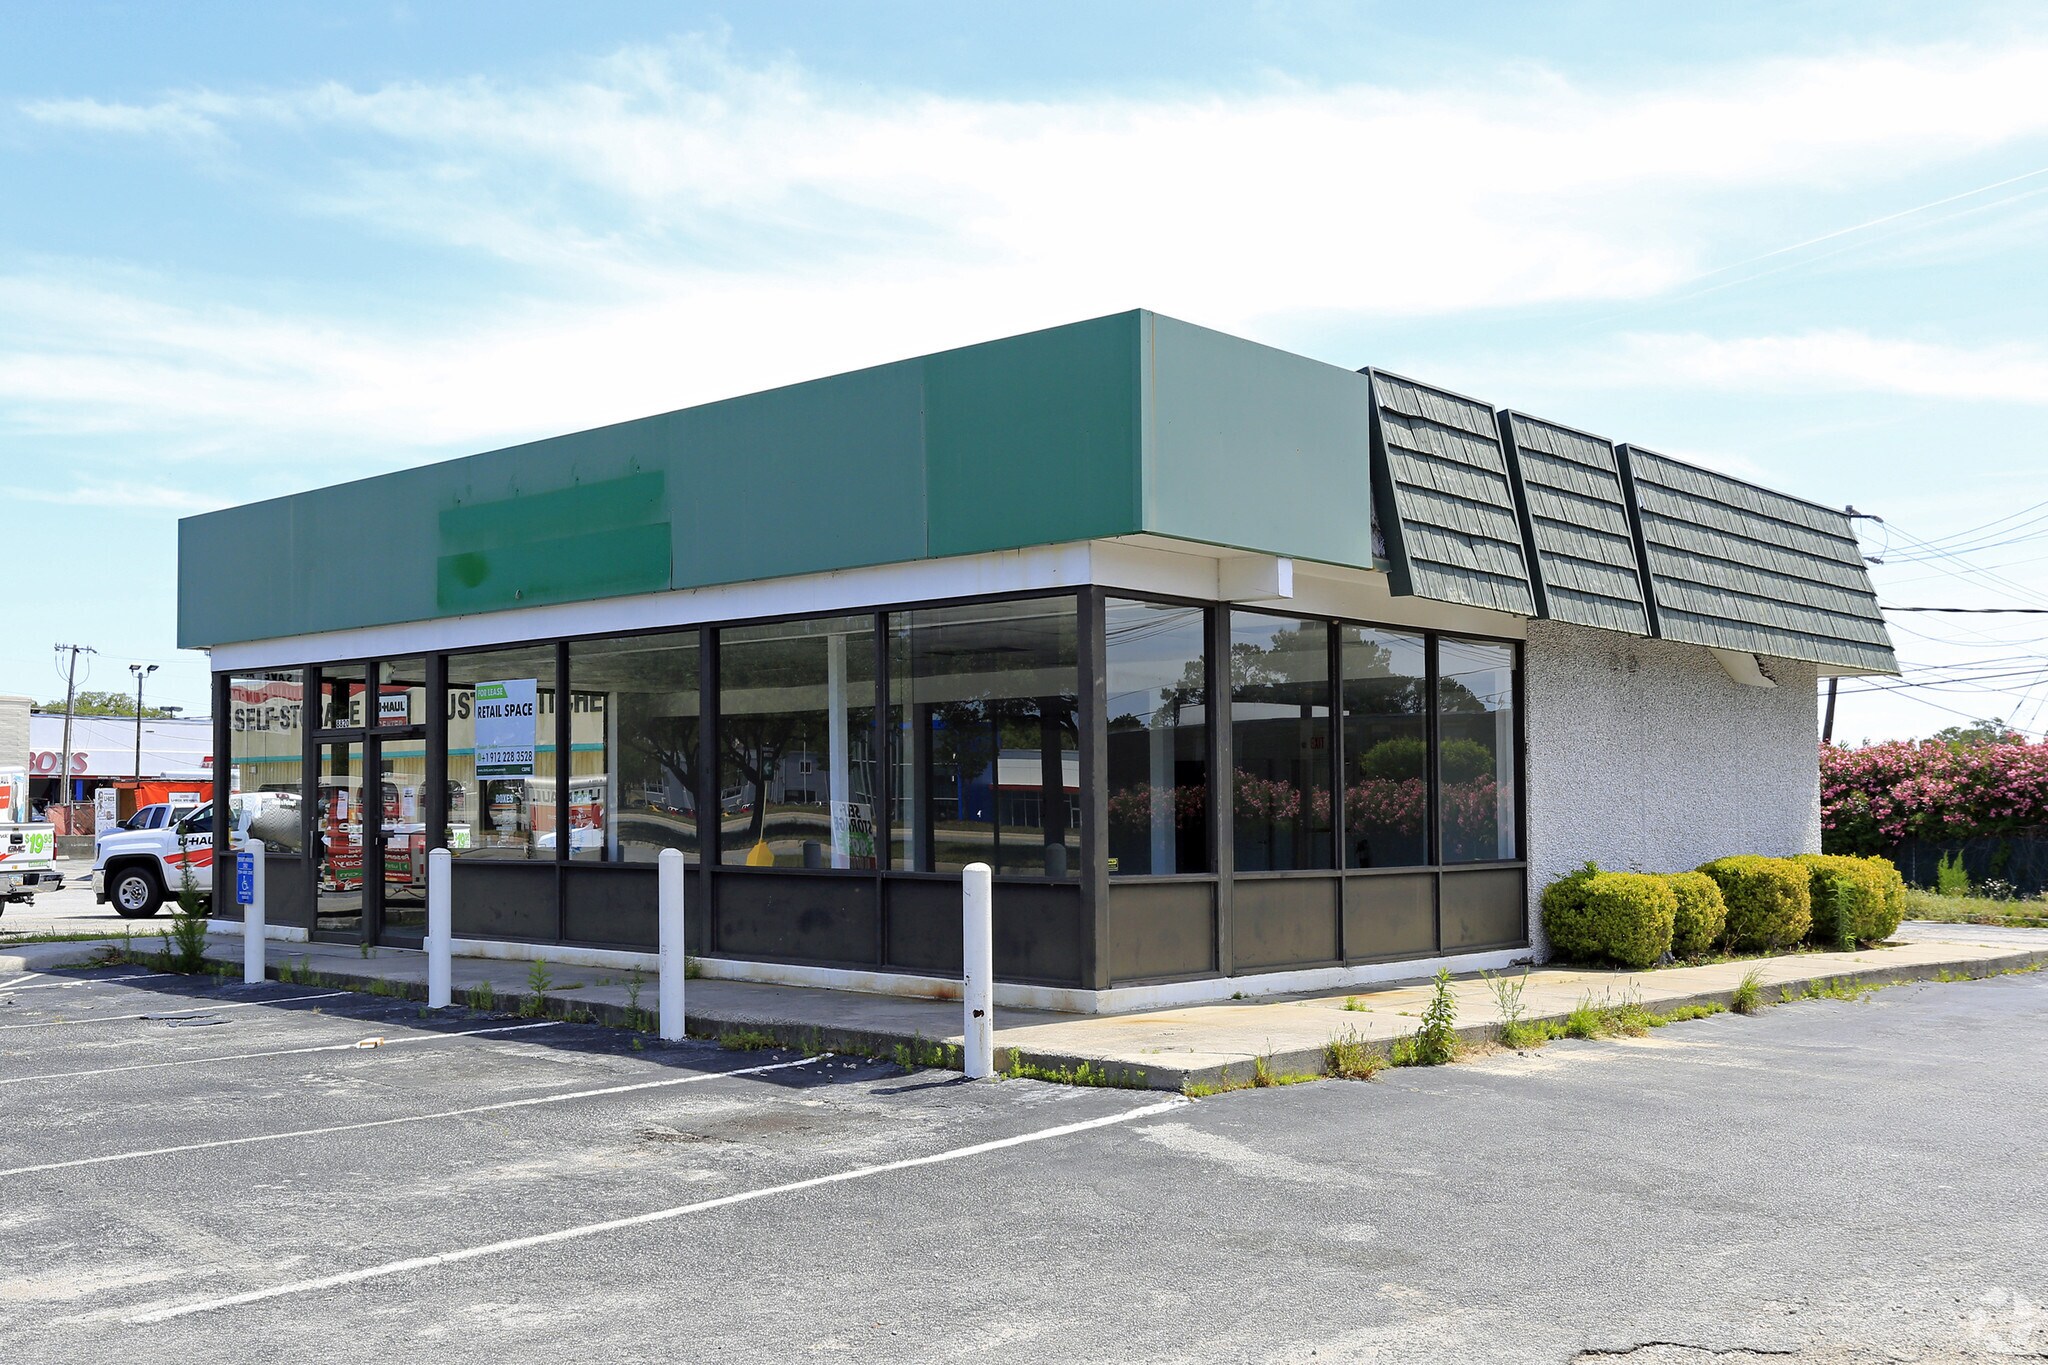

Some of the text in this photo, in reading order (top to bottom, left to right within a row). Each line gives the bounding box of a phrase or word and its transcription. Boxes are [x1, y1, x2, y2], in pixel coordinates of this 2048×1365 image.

[488, 688, 503, 696] LEASE
[478, 705, 502, 719] RETAIL
[504, 703, 533, 717] SPACE
[29, 751, 88, 773] OS
[490, 752, 501, 762] 912
[502, 752, 515, 761] 228
[516, 751, 533, 761] 3528
